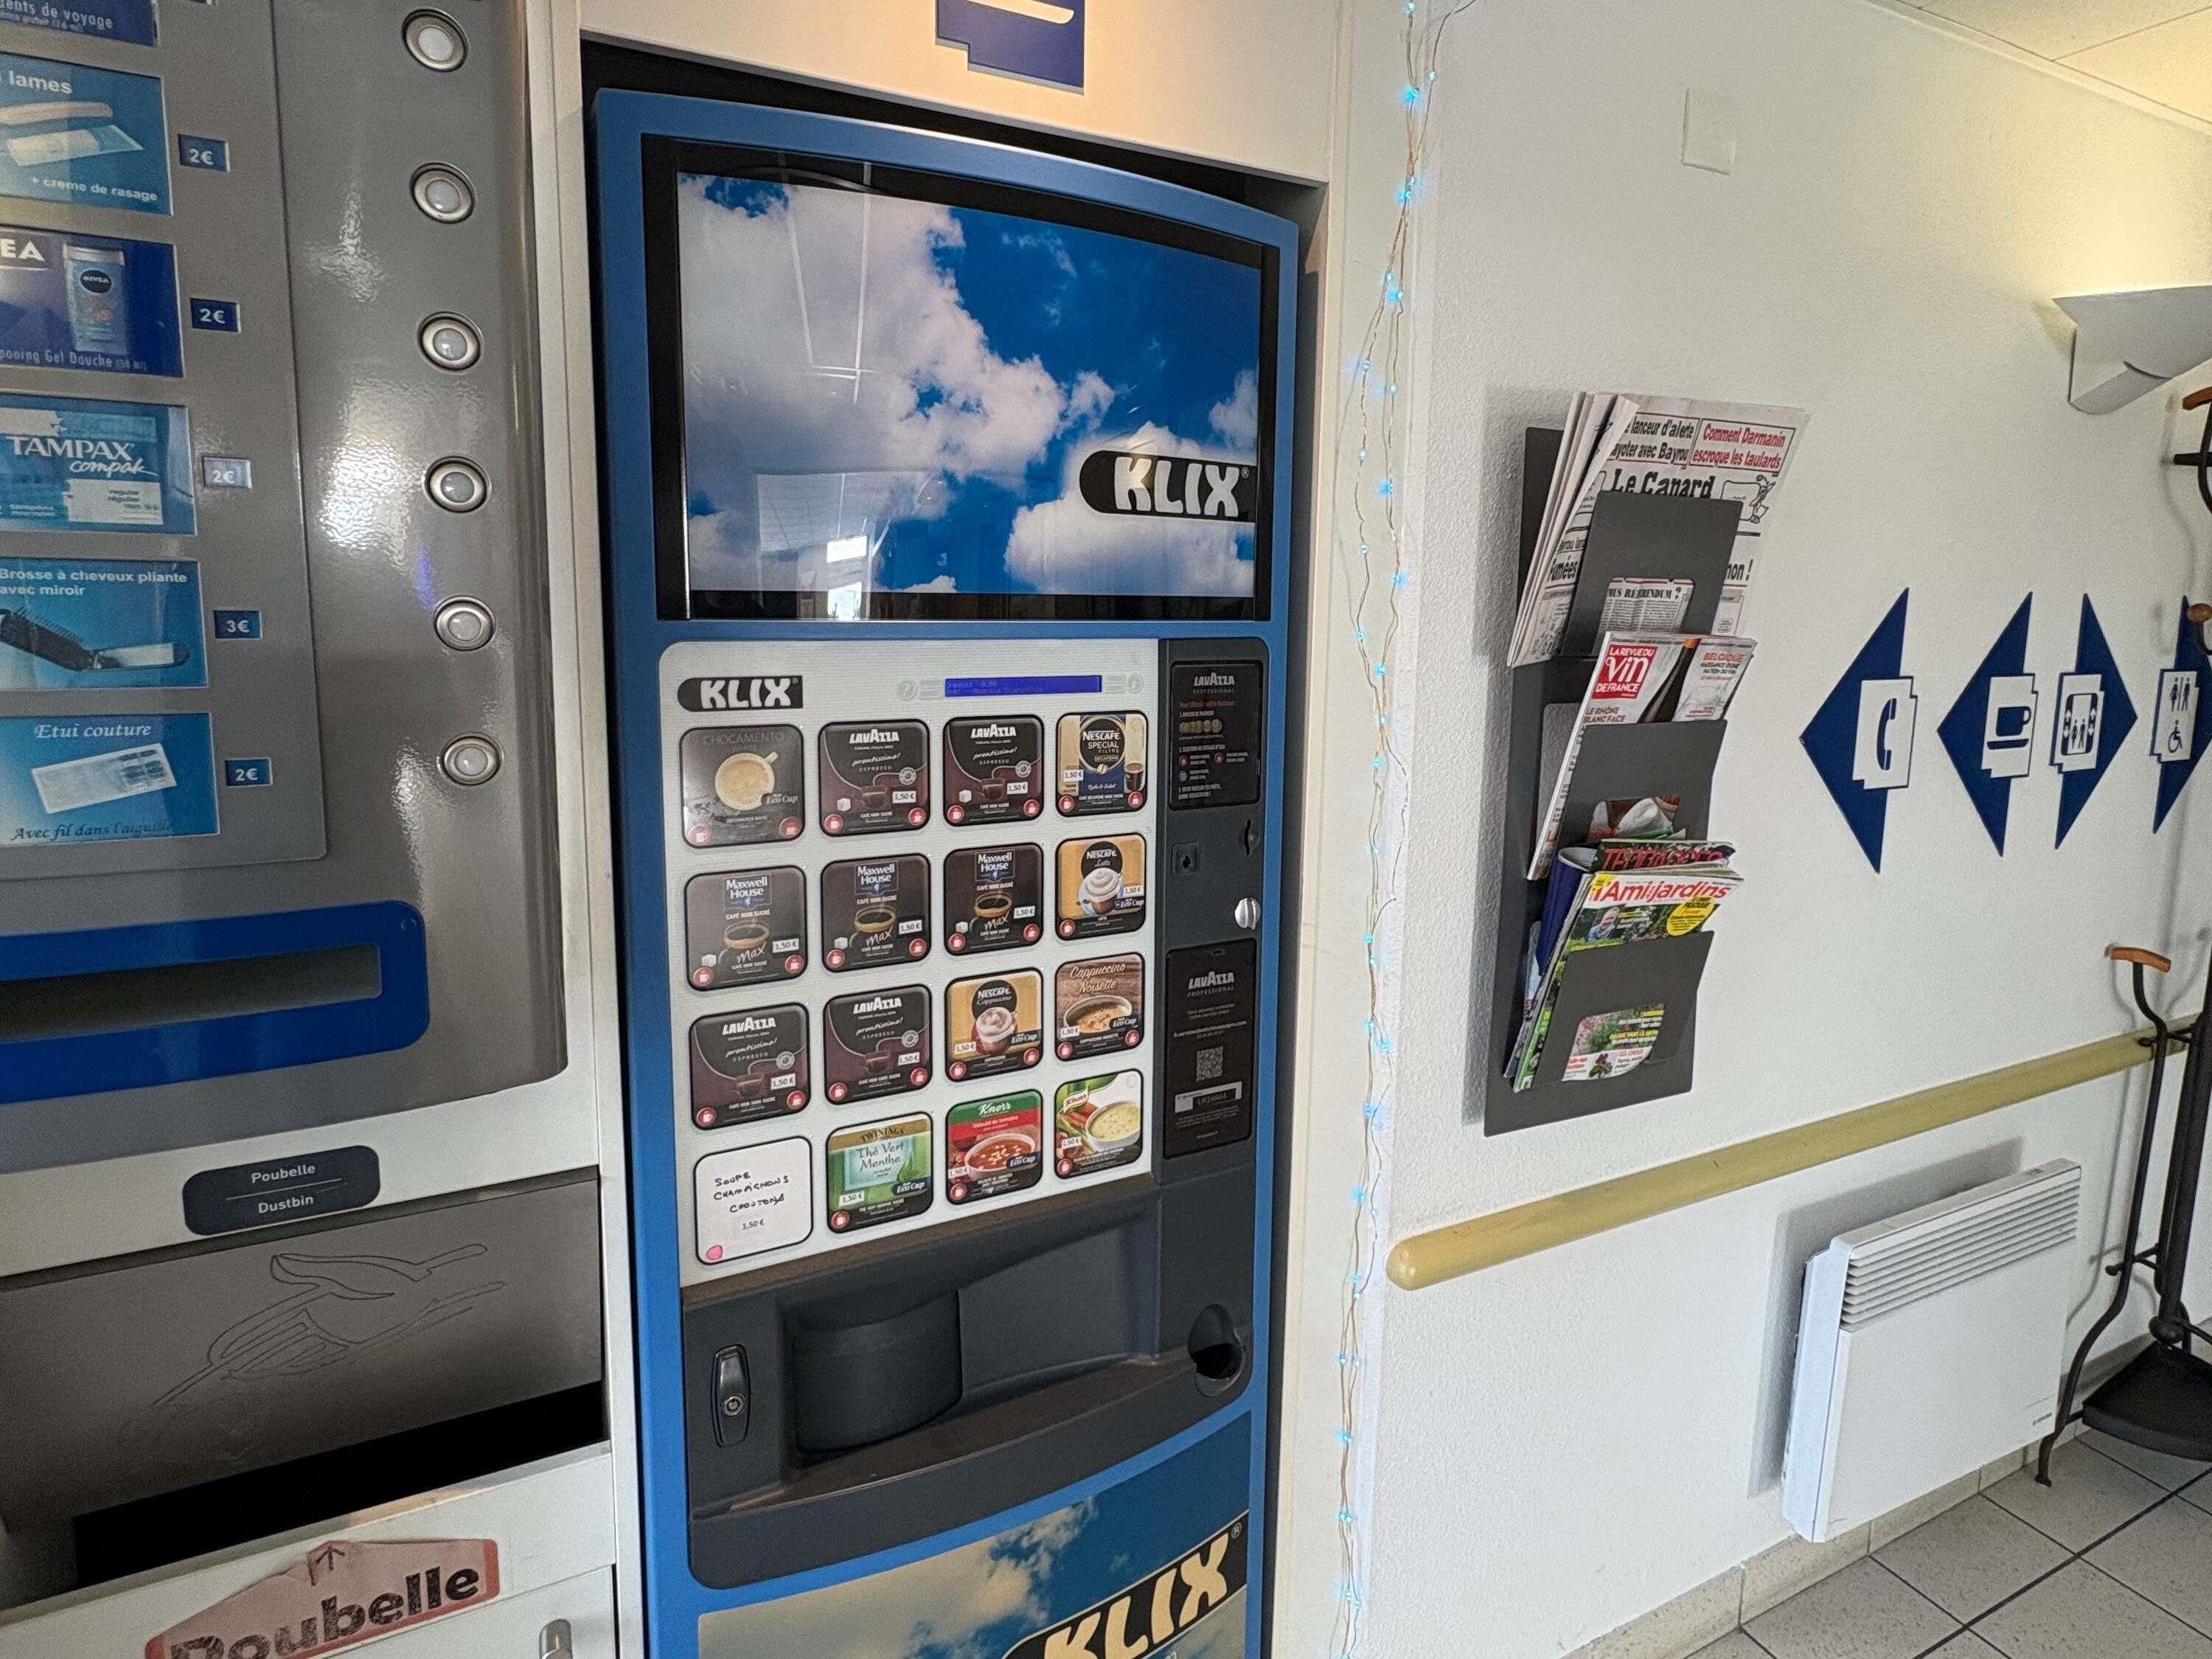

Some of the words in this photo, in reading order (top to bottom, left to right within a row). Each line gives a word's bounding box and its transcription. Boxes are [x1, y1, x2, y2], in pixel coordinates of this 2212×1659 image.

[0, 0, 36, 15] ents
[41, 2, 58, 18] de
[63, 10, 113, 30] voyage
[8, 70, 73, 95] lames
[188, 148, 214, 165] 2€
[91, 181, 108, 195] de
[111, 185, 158, 203] rasage
[198, 308, 226, 324] 2€
[44, 349, 64, 364] Gel
[69, 352, 113, 367] Douche
[1630, 417, 1660, 436] lanceur
[1661, 419, 1694, 439] d'alerte
[1703, 423, 1742, 443] Comment
[1742, 428, 1787, 448] Darmanin
[6, 435, 133, 462] TAMPAX
[1610, 440, 1638, 460] ayoter
[1638, 443, 1658, 459] avec
[1658, 442, 1690, 465] Bayrou
[1692, 448, 1730, 467] escroque
[1731, 448, 1743, 465] les
[1744, 451, 1783, 470] taulards
[69, 457, 159, 479] compak
[212, 469, 235, 485] 2€
[1610, 469, 1637, 493] Le
[1640, 470, 1717, 500] Canard
[1114, 456, 1240, 518] KLIX
[0, 568, 52, 580] Brosse
[57, 568, 67, 580] à
[70, 571, 134, 582] cheveux
[137, 571, 187, 584] pliante
[1725, 563, 1745, 580] non
[0, 586, 36, 595] avec
[40, 585, 86, 597] miroir
[1674, 587, 1682, 599] ?
[226, 619, 251, 634] 3€
[1609, 647, 1620, 655] LA
[1620, 647, 1644, 656] REVUE
[1643, 648, 1655, 657] DU
[1703, 652, 1745, 662] BELGIQUE
[1193, 672, 1236, 686] LAVAZZA
[1595, 683, 1607, 692] DE
[1607, 683, 1641, 692] FRANCE
[700, 678, 793, 709] KLIX
[35, 723, 80, 740] Etui
[83, 724, 152, 738] couture
[849, 728, 900, 745] LAVAZZA
[970, 724, 1017, 739] LAVAZZA
[235, 768, 258, 782] 2€
[11, 828, 52, 841] Avec
[50, 824, 72, 841] fil
[74, 823, 109, 838] dans
[978, 852, 1012, 864] Maxwell
[858, 863, 895, 877] Maxwell
[981, 862, 1009, 872] House
[726, 876, 768, 891] Maxwell
[860, 874, 892, 885] House
[730, 888, 765, 899] House
[1070, 963, 1126, 980] Cappuccino
[1188, 970, 1235, 990] LAVAZZA
[1079, 979, 1117, 993] Noisette
[853, 997, 902, 1015] LAVAZZA
[722, 1017, 776, 1036] LAVAZZA
[978, 1102, 1012, 1116] Knorr
[860, 1125, 905, 1142] TWININGS
[856, 1145, 879, 1158] Thé
[881, 1141, 904, 1153] Vert
[860, 1155, 901, 1172] Menthe
[251, 1164, 317, 1184] Poubelle
[714, 1172, 751, 1187] SOUPE
[257, 1194, 314, 1214] Dustbin
[1044, 1532, 1230, 1659] KLIX
[170, 1565, 480, 1659] Poubelle
